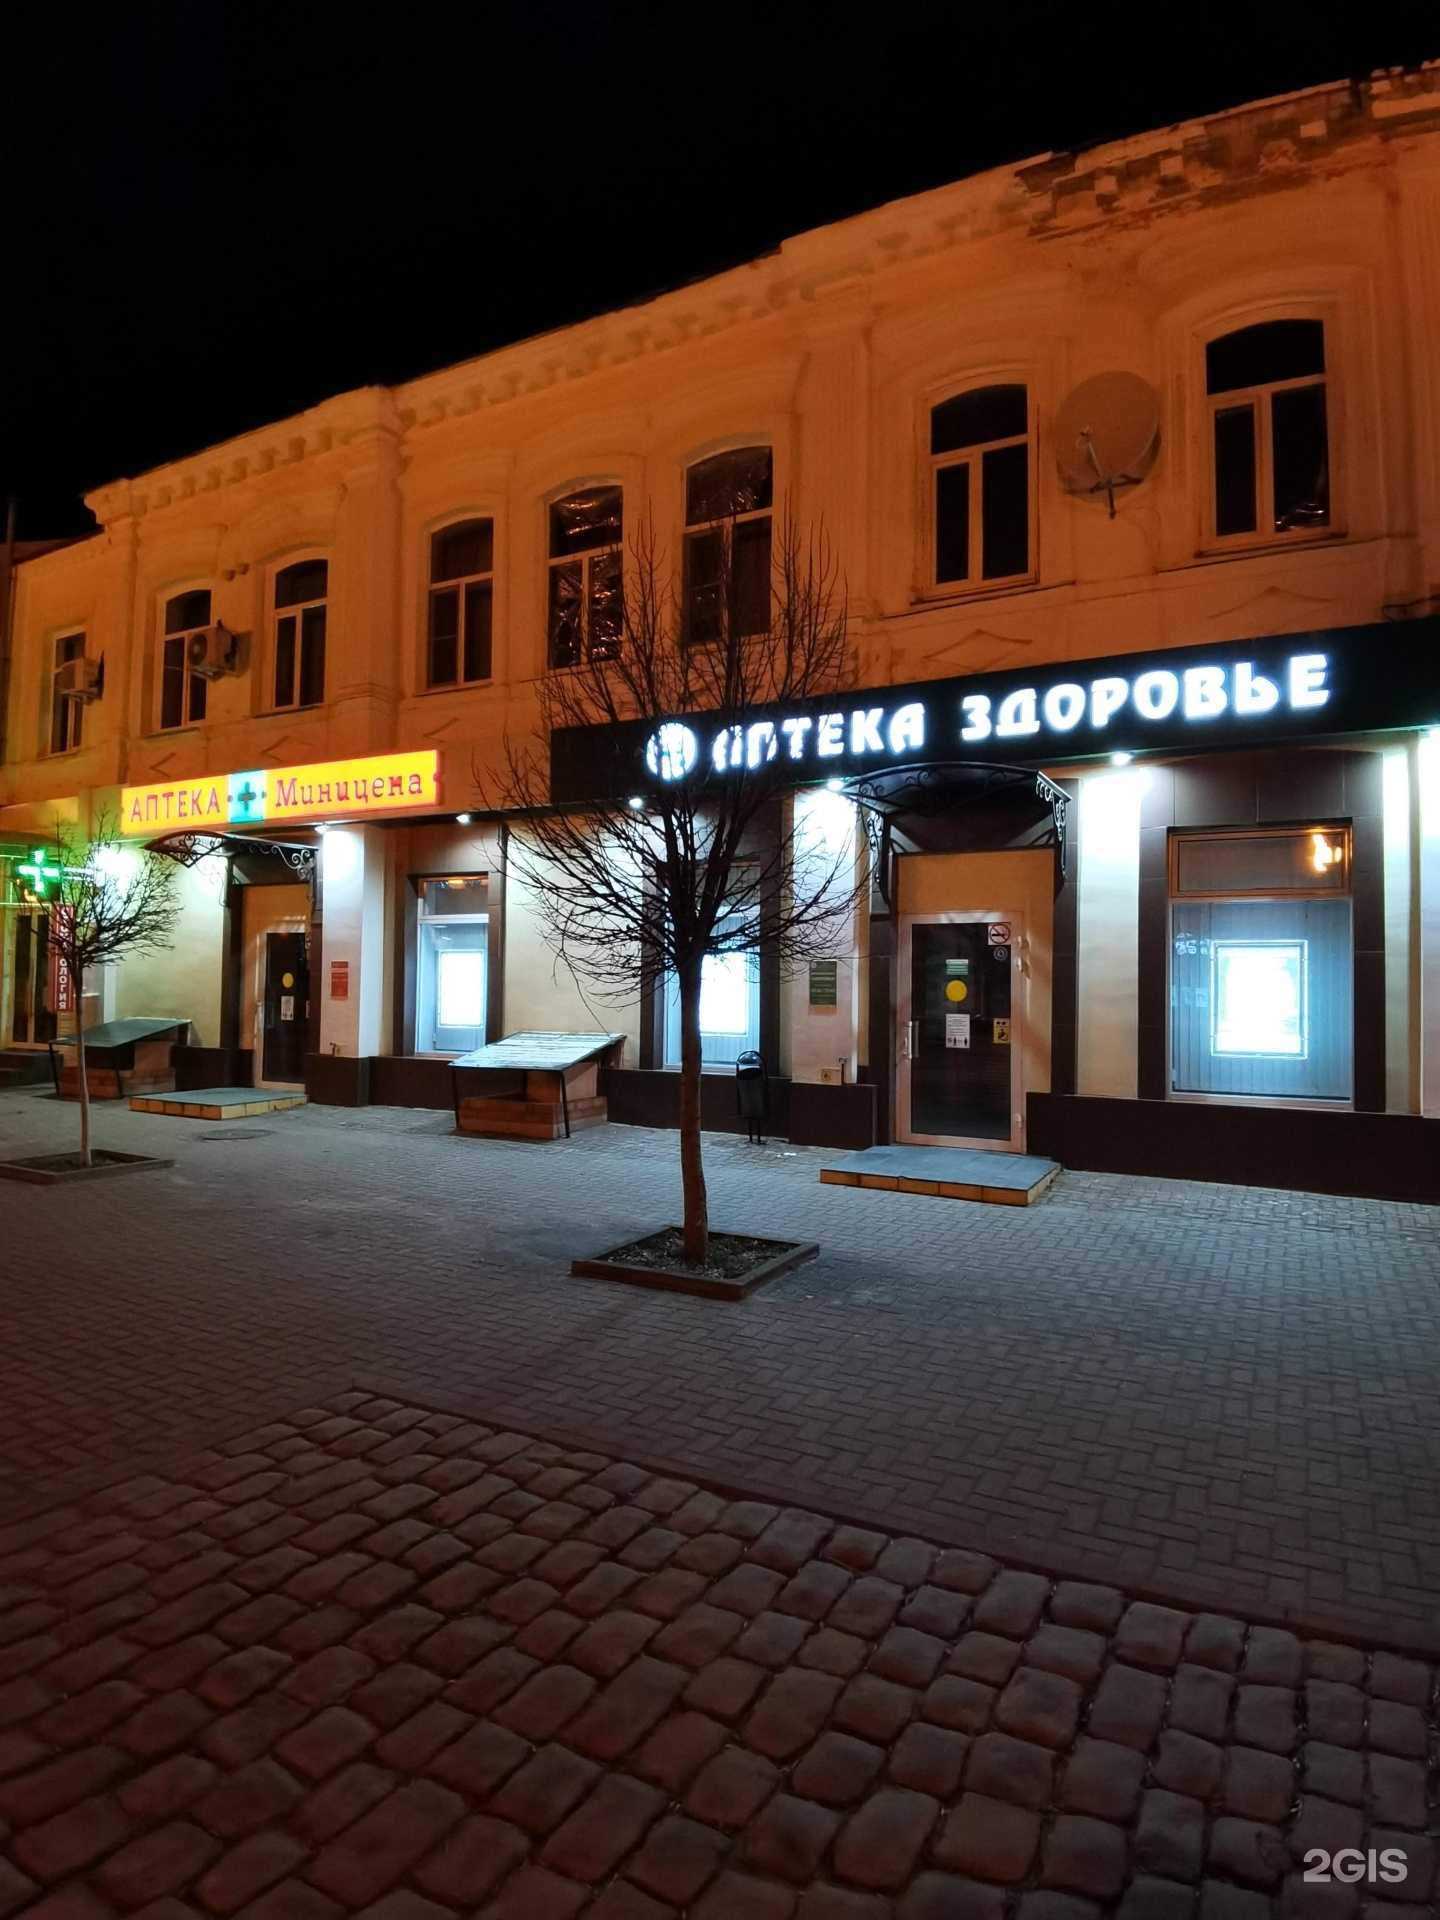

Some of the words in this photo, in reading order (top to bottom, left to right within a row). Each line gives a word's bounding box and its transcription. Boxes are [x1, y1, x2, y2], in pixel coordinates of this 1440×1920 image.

[712, 702, 925, 773] АПТЕКА
[961, 653, 1330, 741] ЗДОРОВЬЕ
[130, 787, 221, 822] АПТЕКА
[275, 772, 423, 808] Миницена
